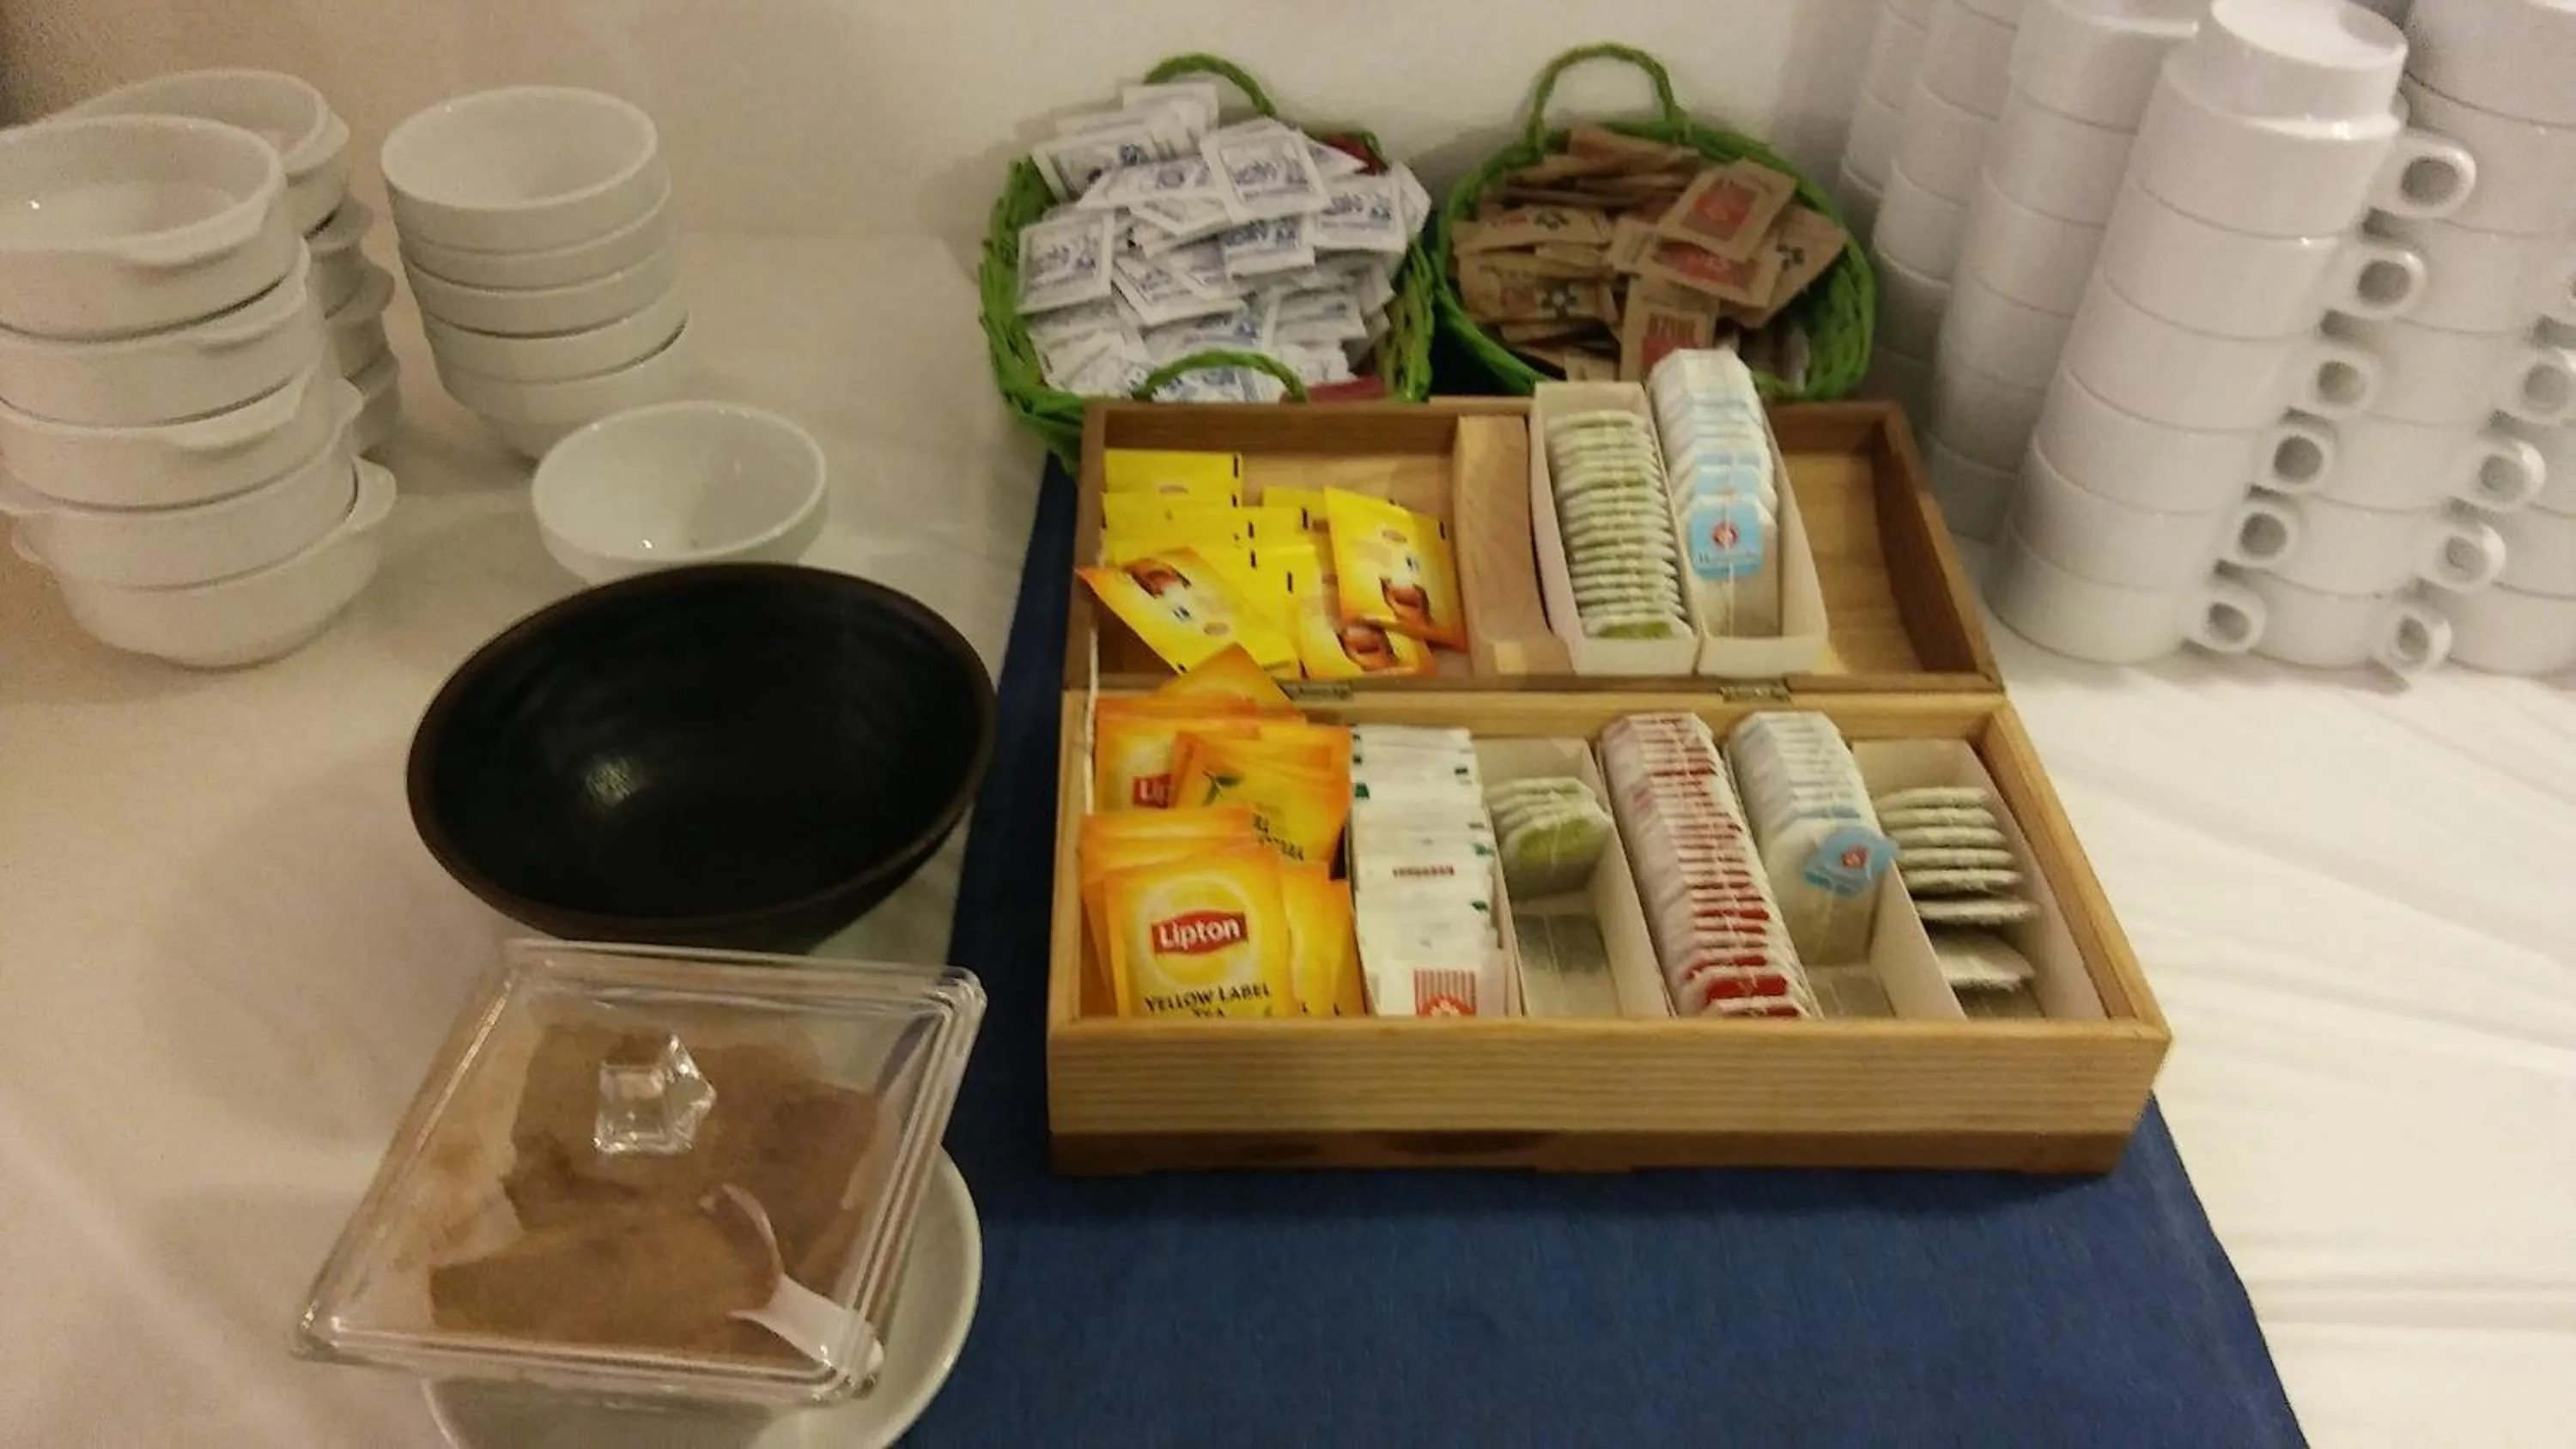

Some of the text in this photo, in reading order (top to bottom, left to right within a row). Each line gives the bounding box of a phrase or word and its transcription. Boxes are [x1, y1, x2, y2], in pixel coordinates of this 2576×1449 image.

[1139, 778, 1175, 805] Lip
[1158, 917, 1242, 950] Lipton
[1143, 981, 1271, 1014] YELLOW LABEL
